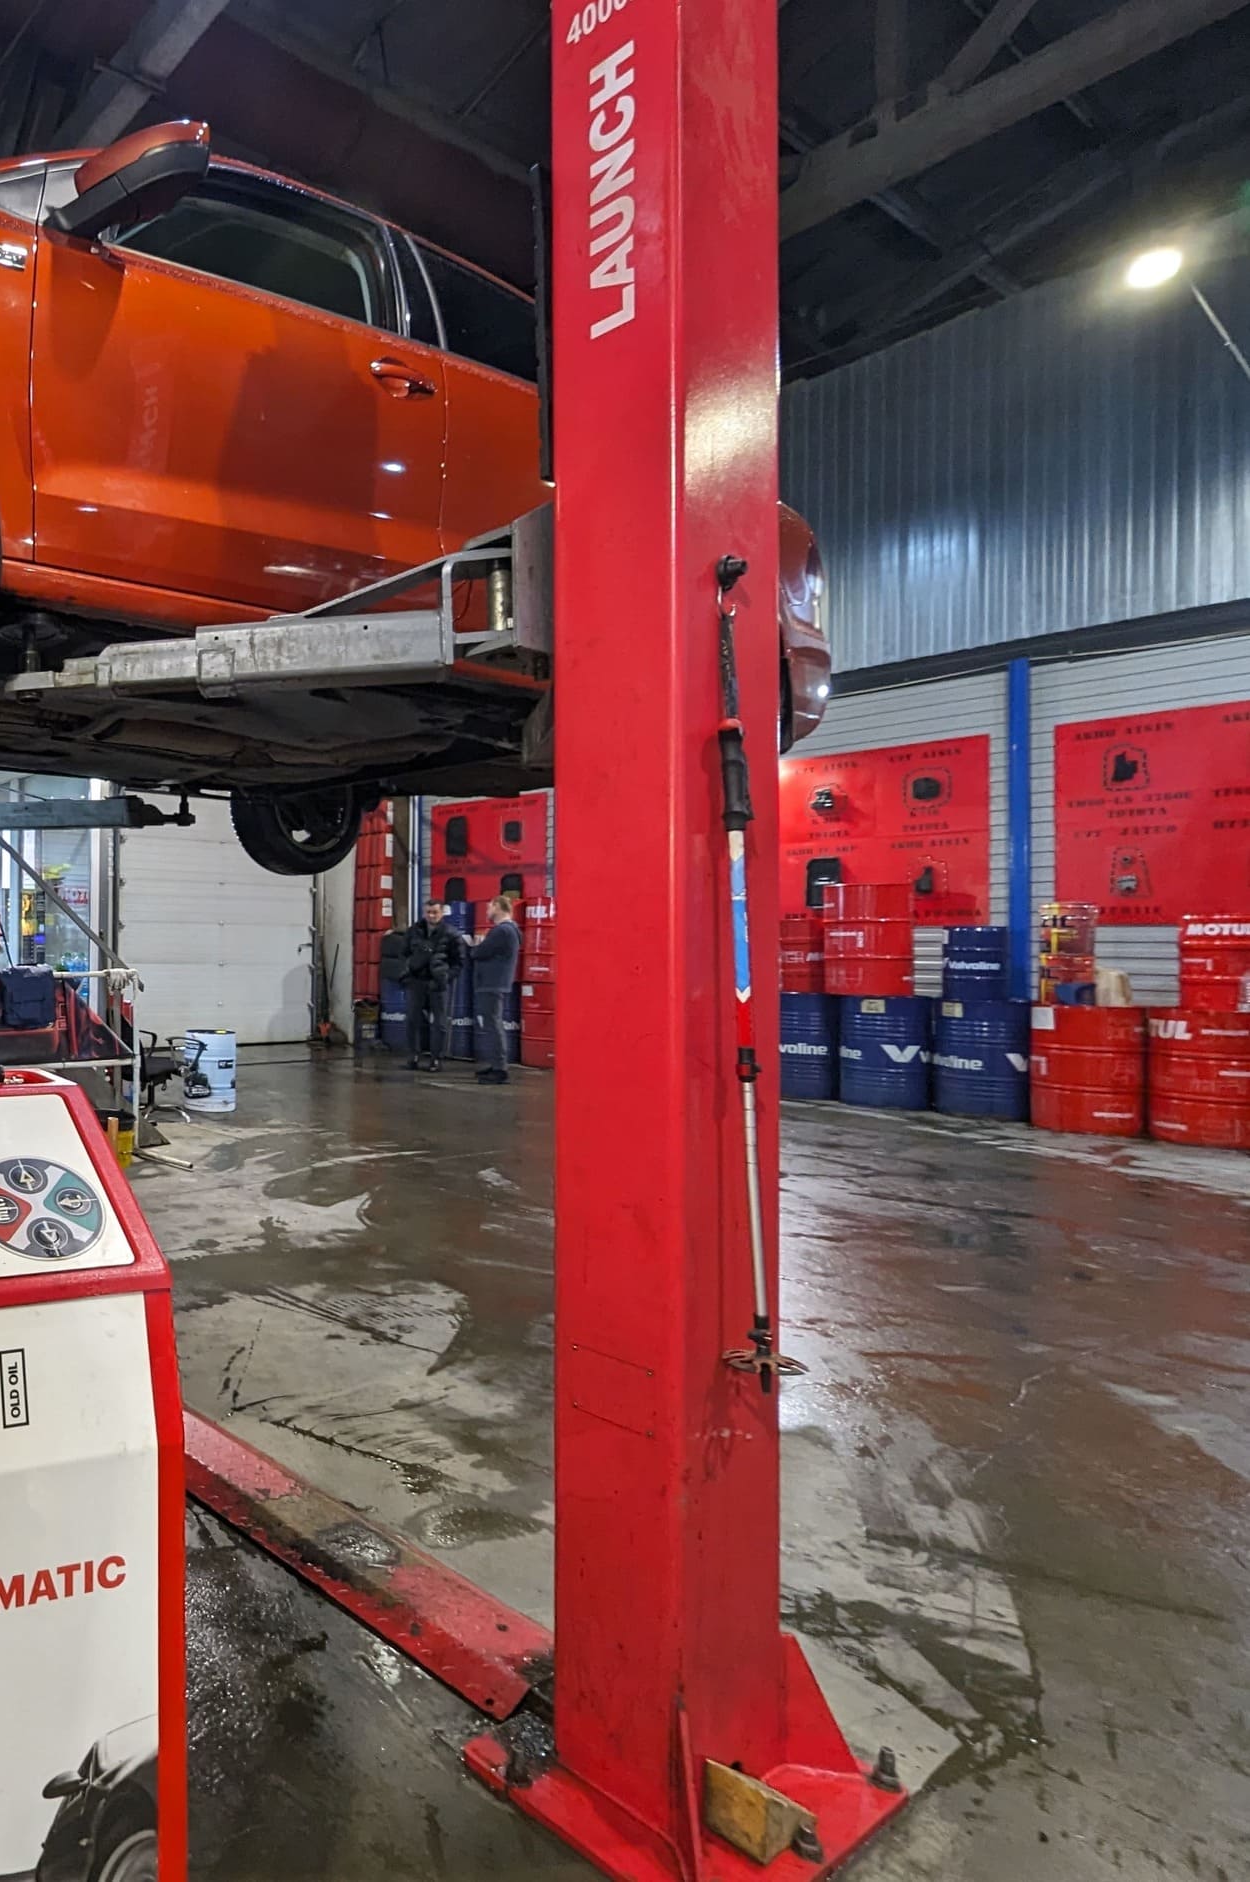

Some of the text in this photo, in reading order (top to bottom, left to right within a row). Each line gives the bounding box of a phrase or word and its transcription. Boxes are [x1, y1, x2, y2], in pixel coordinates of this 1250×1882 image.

[589, 40, 635, 340] LAUNCH
[8, 1361, 21, 1418] OLD OIL
